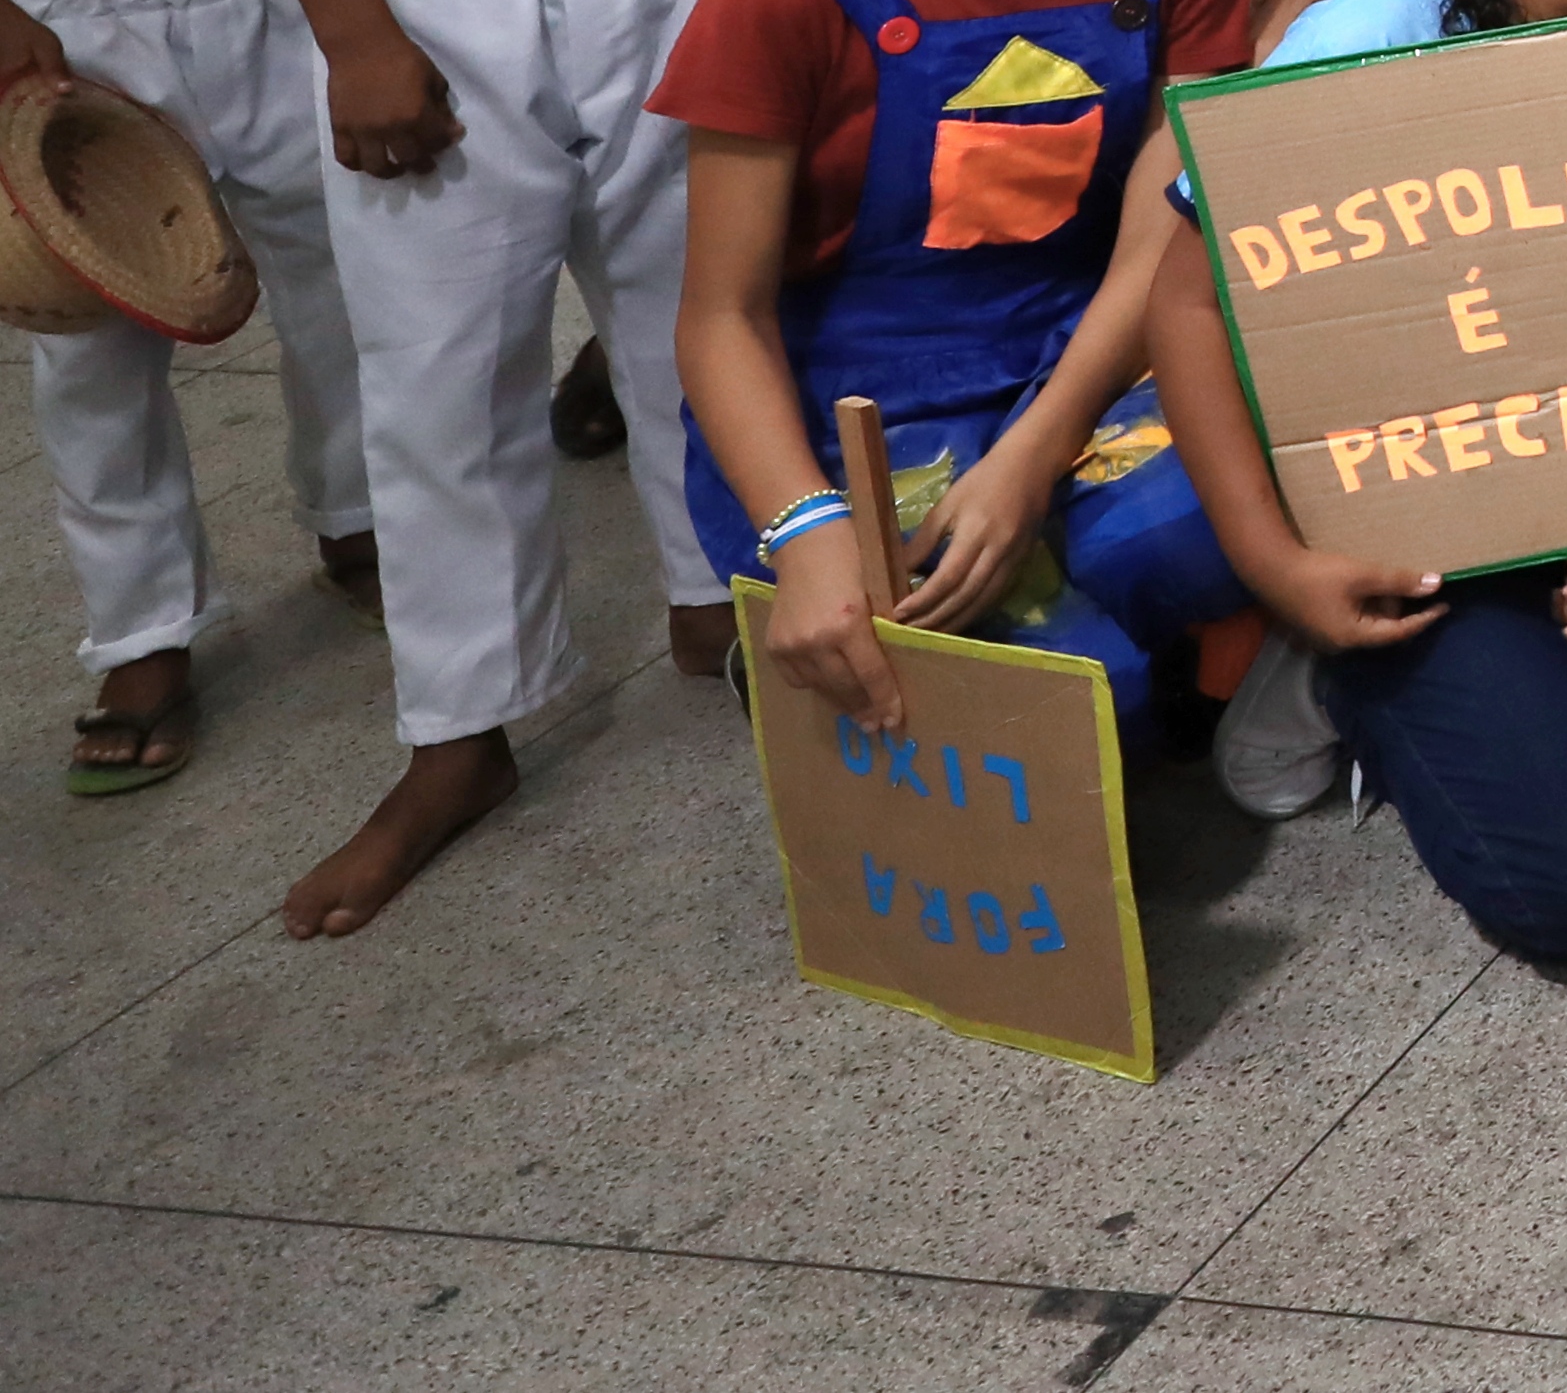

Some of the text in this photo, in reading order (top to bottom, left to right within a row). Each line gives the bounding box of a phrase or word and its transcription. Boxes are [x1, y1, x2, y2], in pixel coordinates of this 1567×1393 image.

[1446, 265, 1508, 355] É
[836, 713, 1032, 825] LIXO
[861, 851, 1067, 956] FORA
